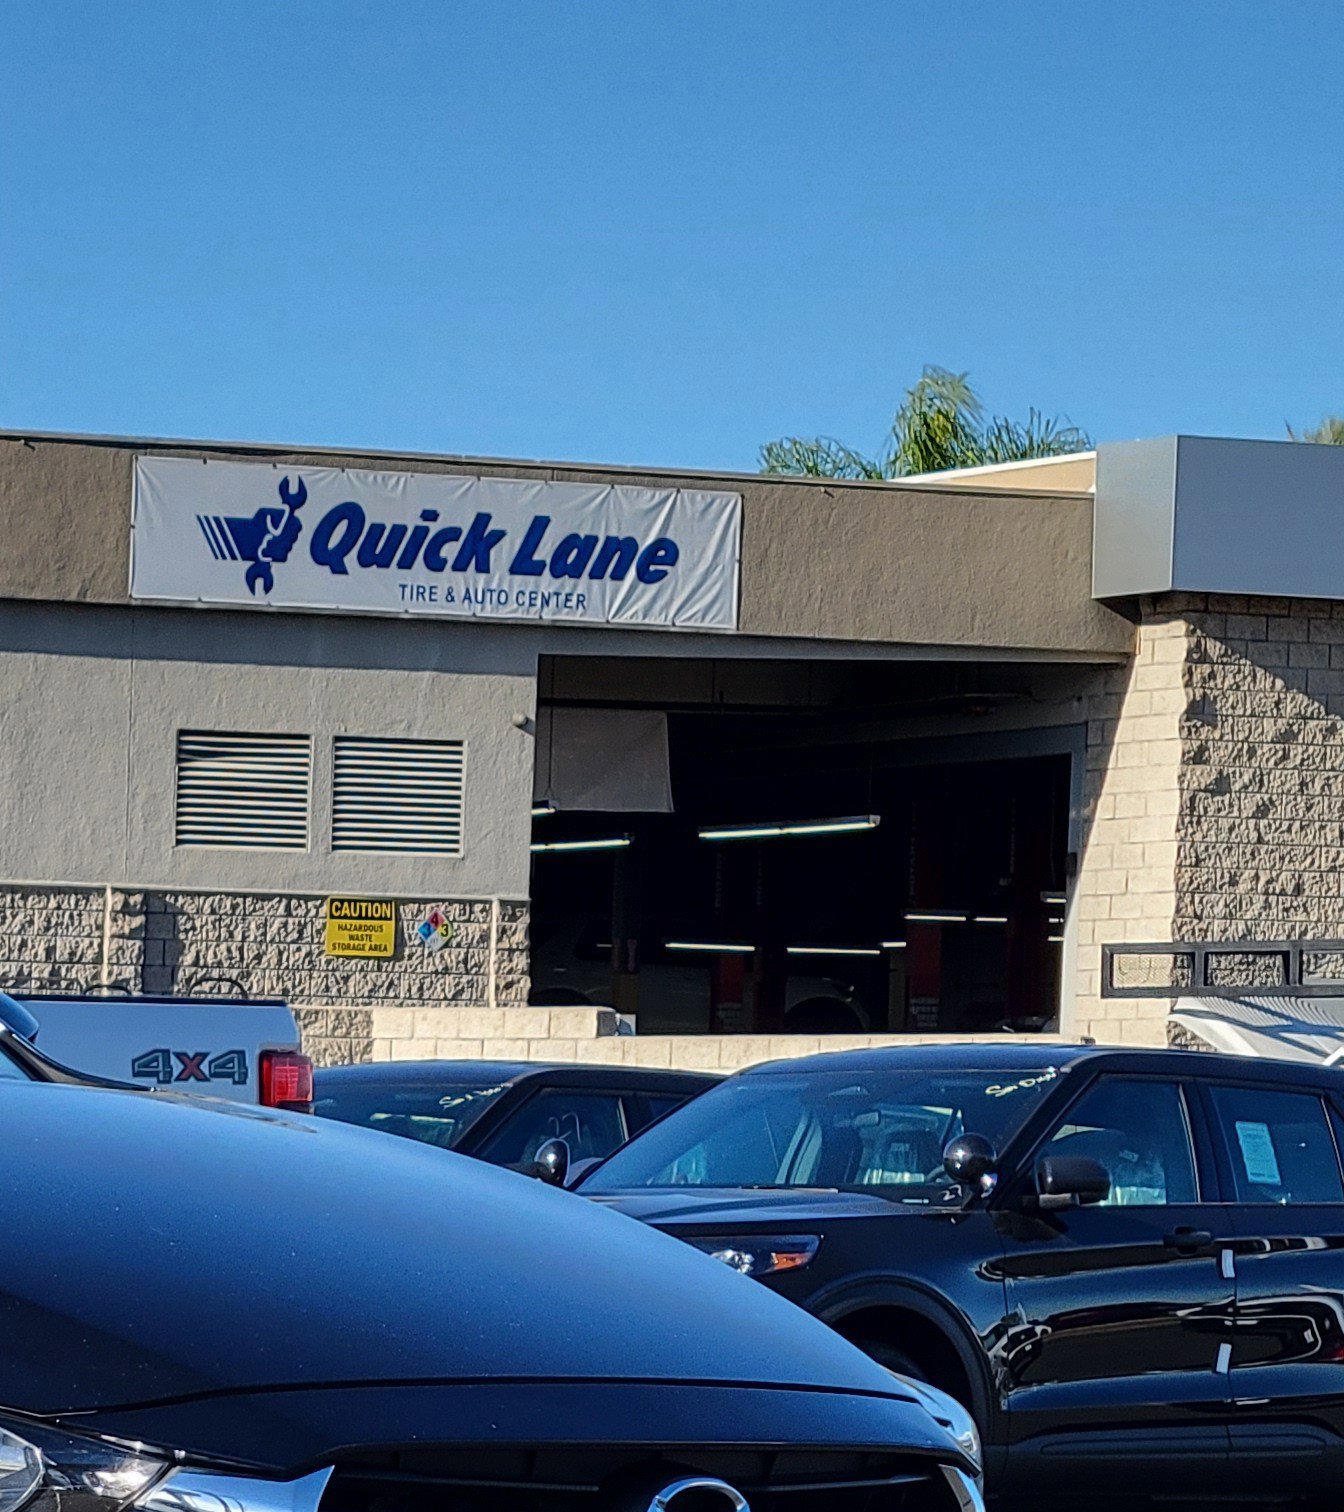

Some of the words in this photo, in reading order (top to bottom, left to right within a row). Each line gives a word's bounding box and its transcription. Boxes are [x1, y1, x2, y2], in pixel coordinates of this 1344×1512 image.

[309, 501, 506, 574] Quick
[508, 515, 679, 584] Lane
[398, 583, 438, 603] TIRE
[444, 586, 456, 603] &
[462, 587, 509, 607] AUTO
[515, 590, 587, 611] CENTER
[331, 901, 391, 919] CAUTION
[430, 912, 439, 928] 4
[337, 923, 384, 933] HAZARDOUS
[440, 923, 449, 937] 3
[348, 933, 373, 942] WASTE
[331, 942, 367, 952] STORAGE
[367, 943, 388, 953] AREA
